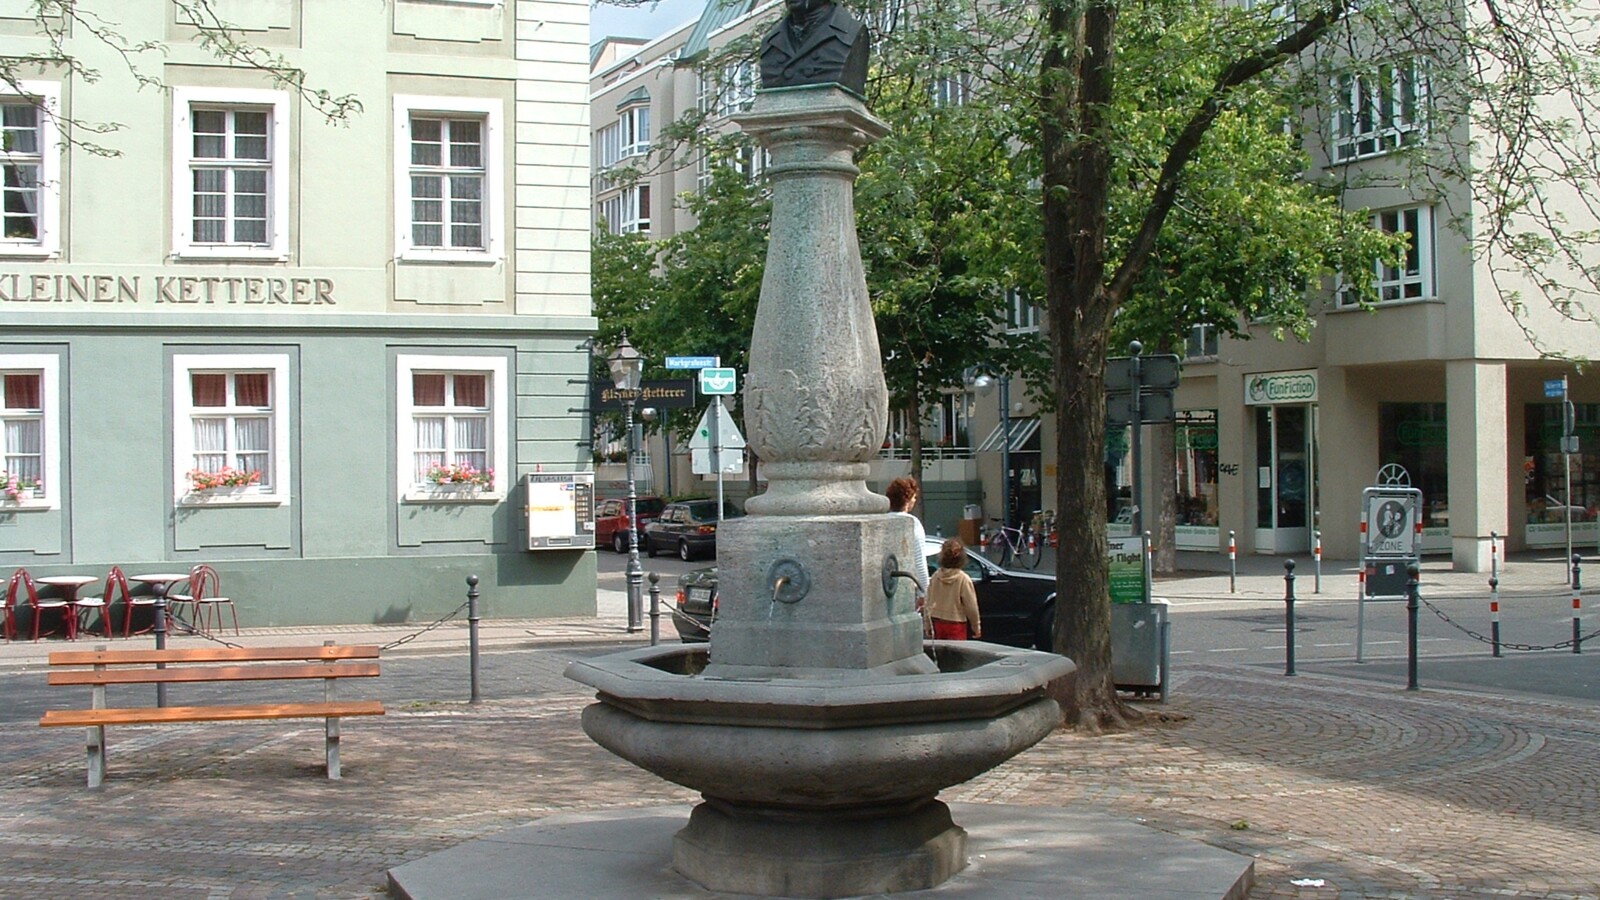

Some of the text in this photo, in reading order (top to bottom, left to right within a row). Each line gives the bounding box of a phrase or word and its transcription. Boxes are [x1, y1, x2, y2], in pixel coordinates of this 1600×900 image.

[155, 276, 336, 305] KETTERER
[642, 387, 686, 401] Ketterer
[1269, 381, 1312, 395] FunFiction
[1379, 541, 1403, 551] ZONE
